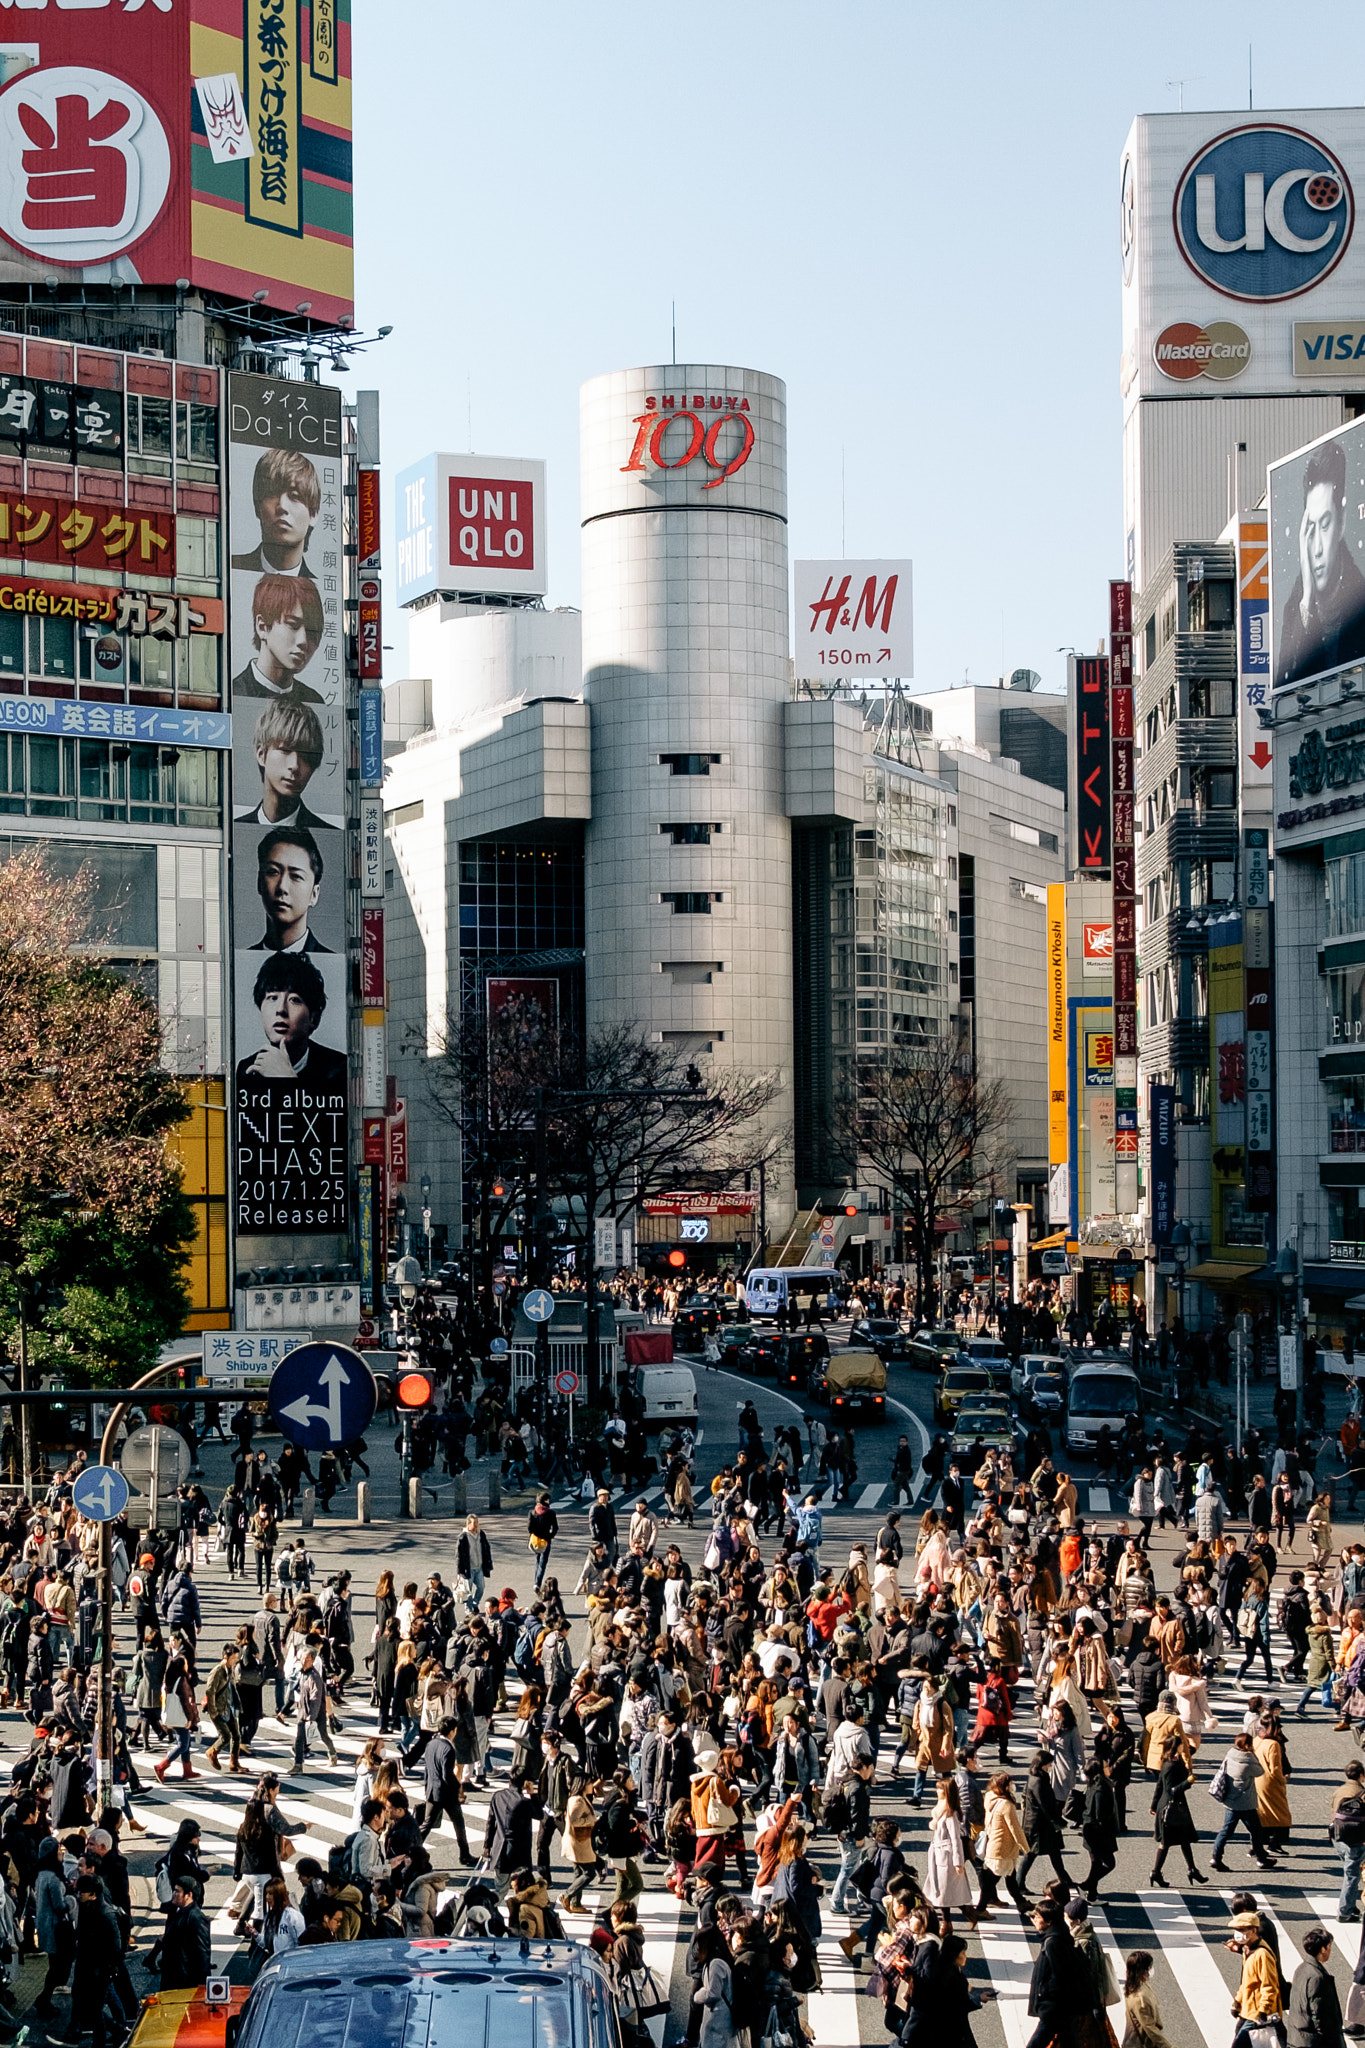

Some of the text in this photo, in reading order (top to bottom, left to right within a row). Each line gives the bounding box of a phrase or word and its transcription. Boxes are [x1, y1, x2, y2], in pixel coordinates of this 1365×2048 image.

[1157, 341, 1250, 361] MasterCard
[262, 389, 309, 411] ダイス
[645, 394, 751, 411] SHIBUYA
[232, 403, 338, 446] Da-iCE
[620, 410, 755, 489] 109
[405, 477, 425, 533] THE
[459, 488, 517, 521] UNI
[0, 502, 167, 559] ンタクト
[459, 525, 523, 561] QLO
[367, 558, 378, 567] 8F
[398, 525, 432, 588] PRIME
[118, 592, 205, 637] ガスト
[809, 574, 899, 635] H&M
[363, 621, 378, 667] ガスト
[1250, 618, 1262, 649] BOOK
[98, 651, 120, 661] ガスト
[62, 704, 226, 740] 英会話イーオン
[365, 700, 377, 777] 英会話イーオン
[365, 808, 378, 888] 渋谷駅前ビル
[364, 910, 383, 921] 5F
[364, 926, 377, 992] La Fiesta
[1053, 920, 1063, 1042] Matsumoto KiYoshi
[1249, 993, 1269, 1006] JTB
[1250, 1047, 1259, 1076] パーラー
[1259, 1042, 1268, 1073] フルーツ
[239, 1088, 344, 1108] 3rd album
[238, 1112, 344, 1143] NEXT
[1159, 1098, 1169, 1146] MIZUHO
[1251, 1107, 1259, 1137] フルーツ
[238, 1148, 344, 1175] PHASE
[392, 1132, 404, 1165] アコム
[239, 1180, 345, 1200] 2017.1.25
[641, 1196, 689, 1207] SHIBUYA
[690, 1196, 709, 1207] 109
[239, 1203, 345, 1225] Release!!
[680, 1225, 709, 1242] 109
[254, 1288, 354, 1305] 渋谷駅前ビル
[226, 1360, 268, 1374] Shibuya
